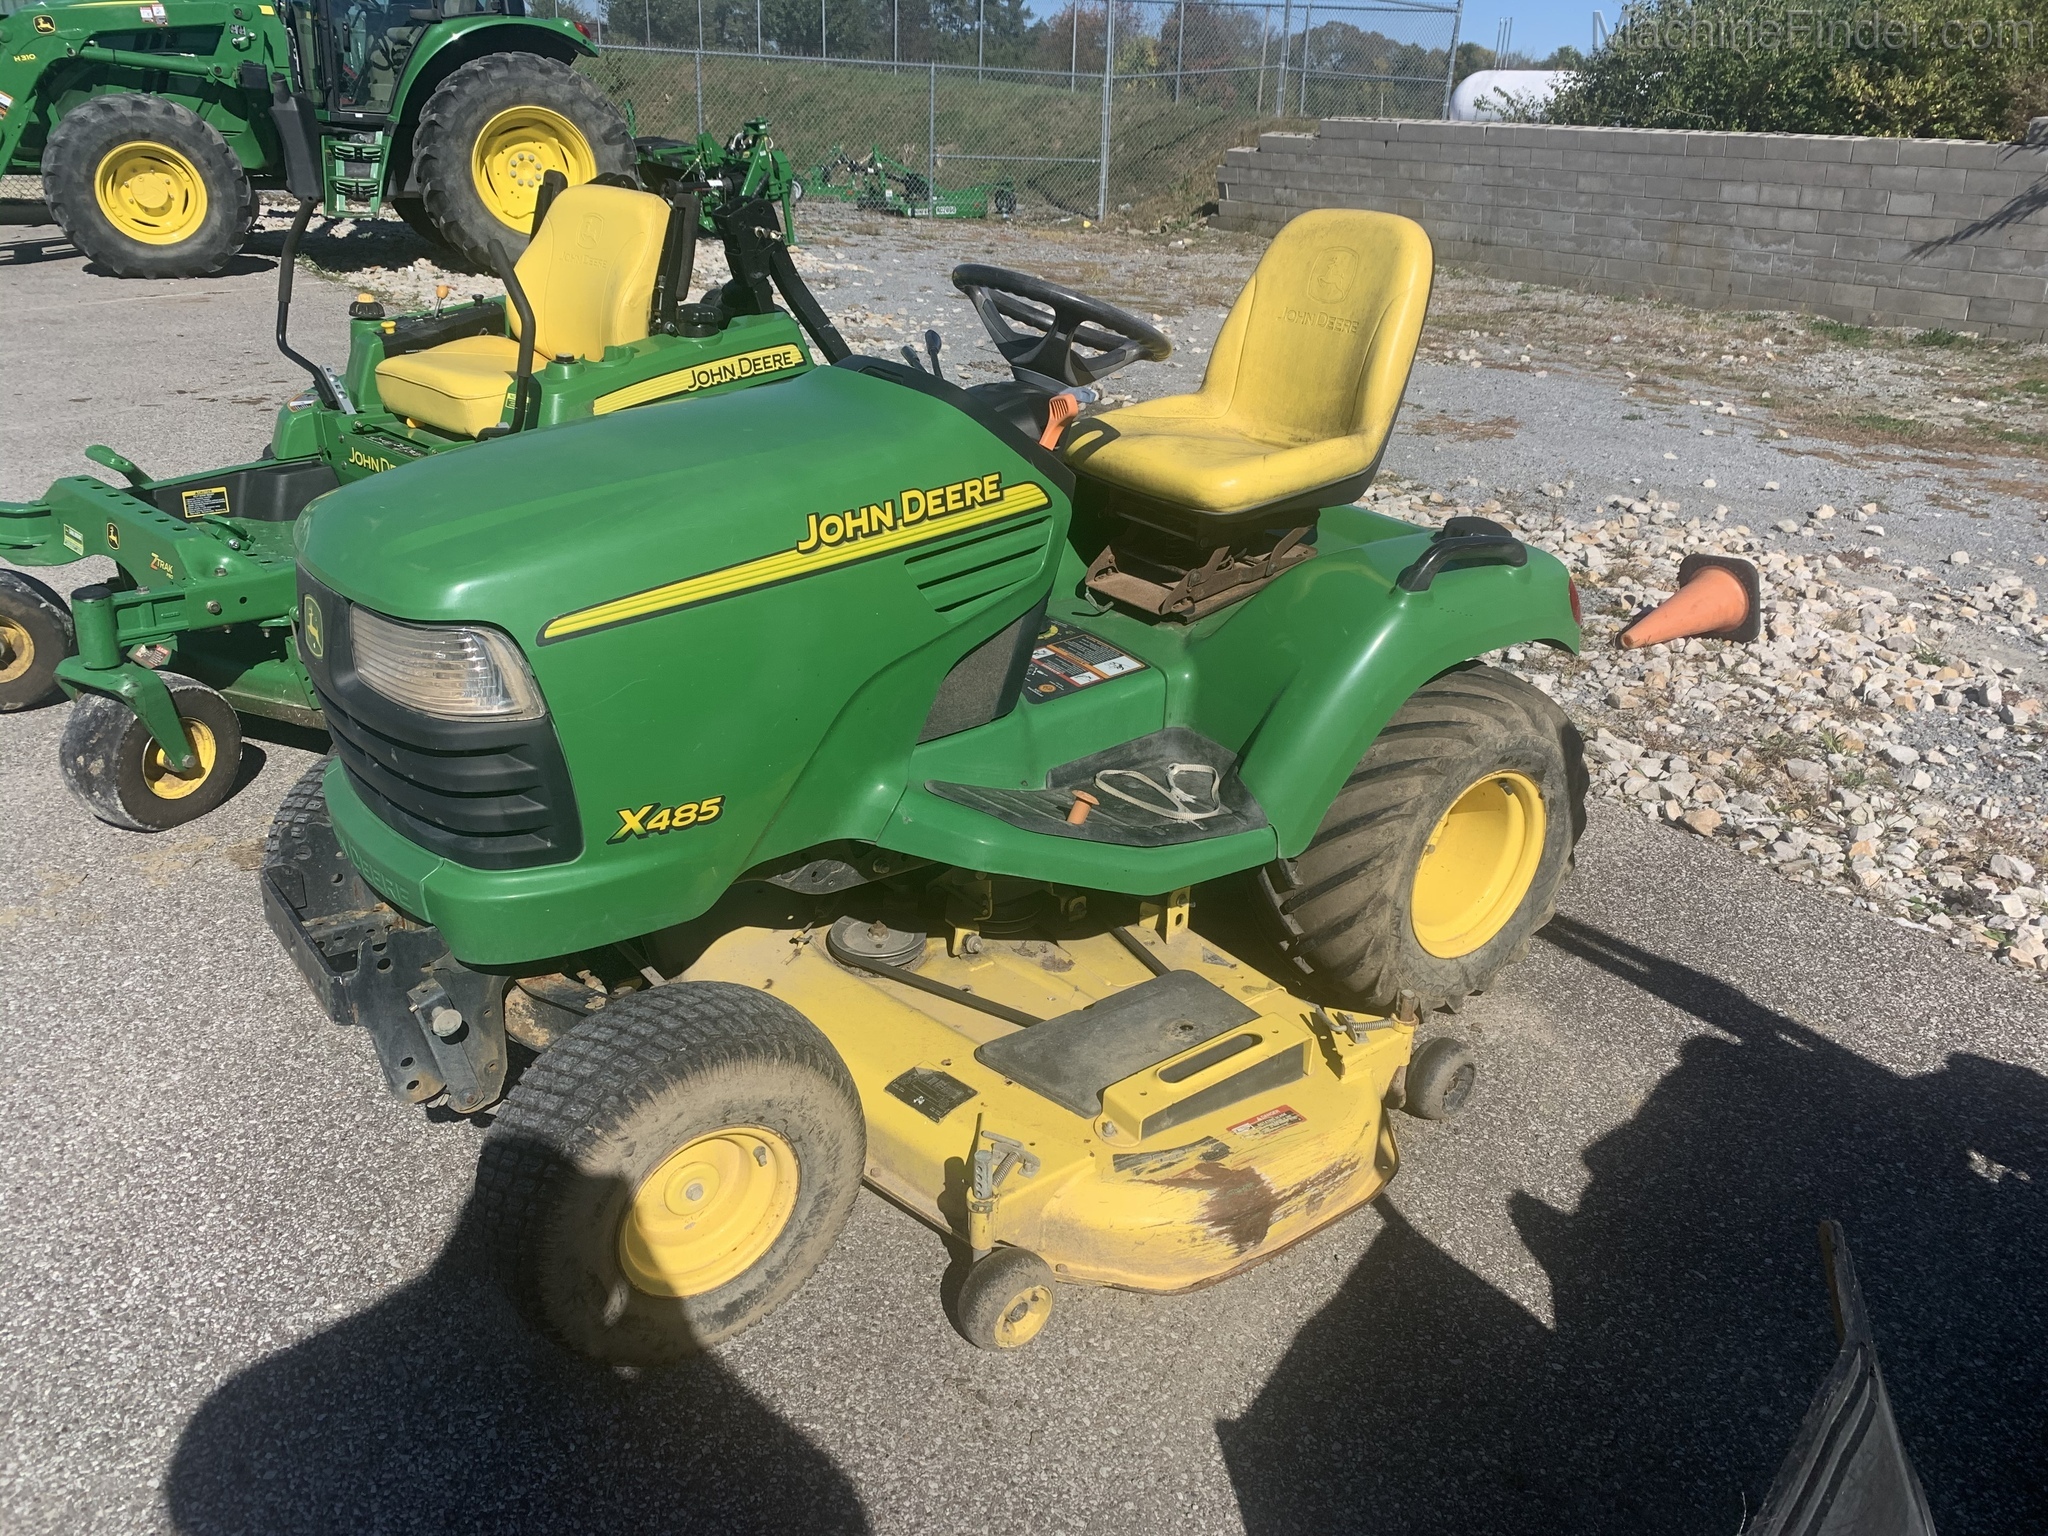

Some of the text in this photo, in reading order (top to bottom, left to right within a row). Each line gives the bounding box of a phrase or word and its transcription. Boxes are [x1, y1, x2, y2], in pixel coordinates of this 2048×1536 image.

[13, 53, 36, 62] H310
[1276, 307, 1359, 334] JOHN DEERE
[688, 352, 793, 389] JOHN DEERE
[349, 447, 380, 472] JOHN
[797, 473, 1001, 552] JOHN DEERE
[608, 796, 723, 842] X485
